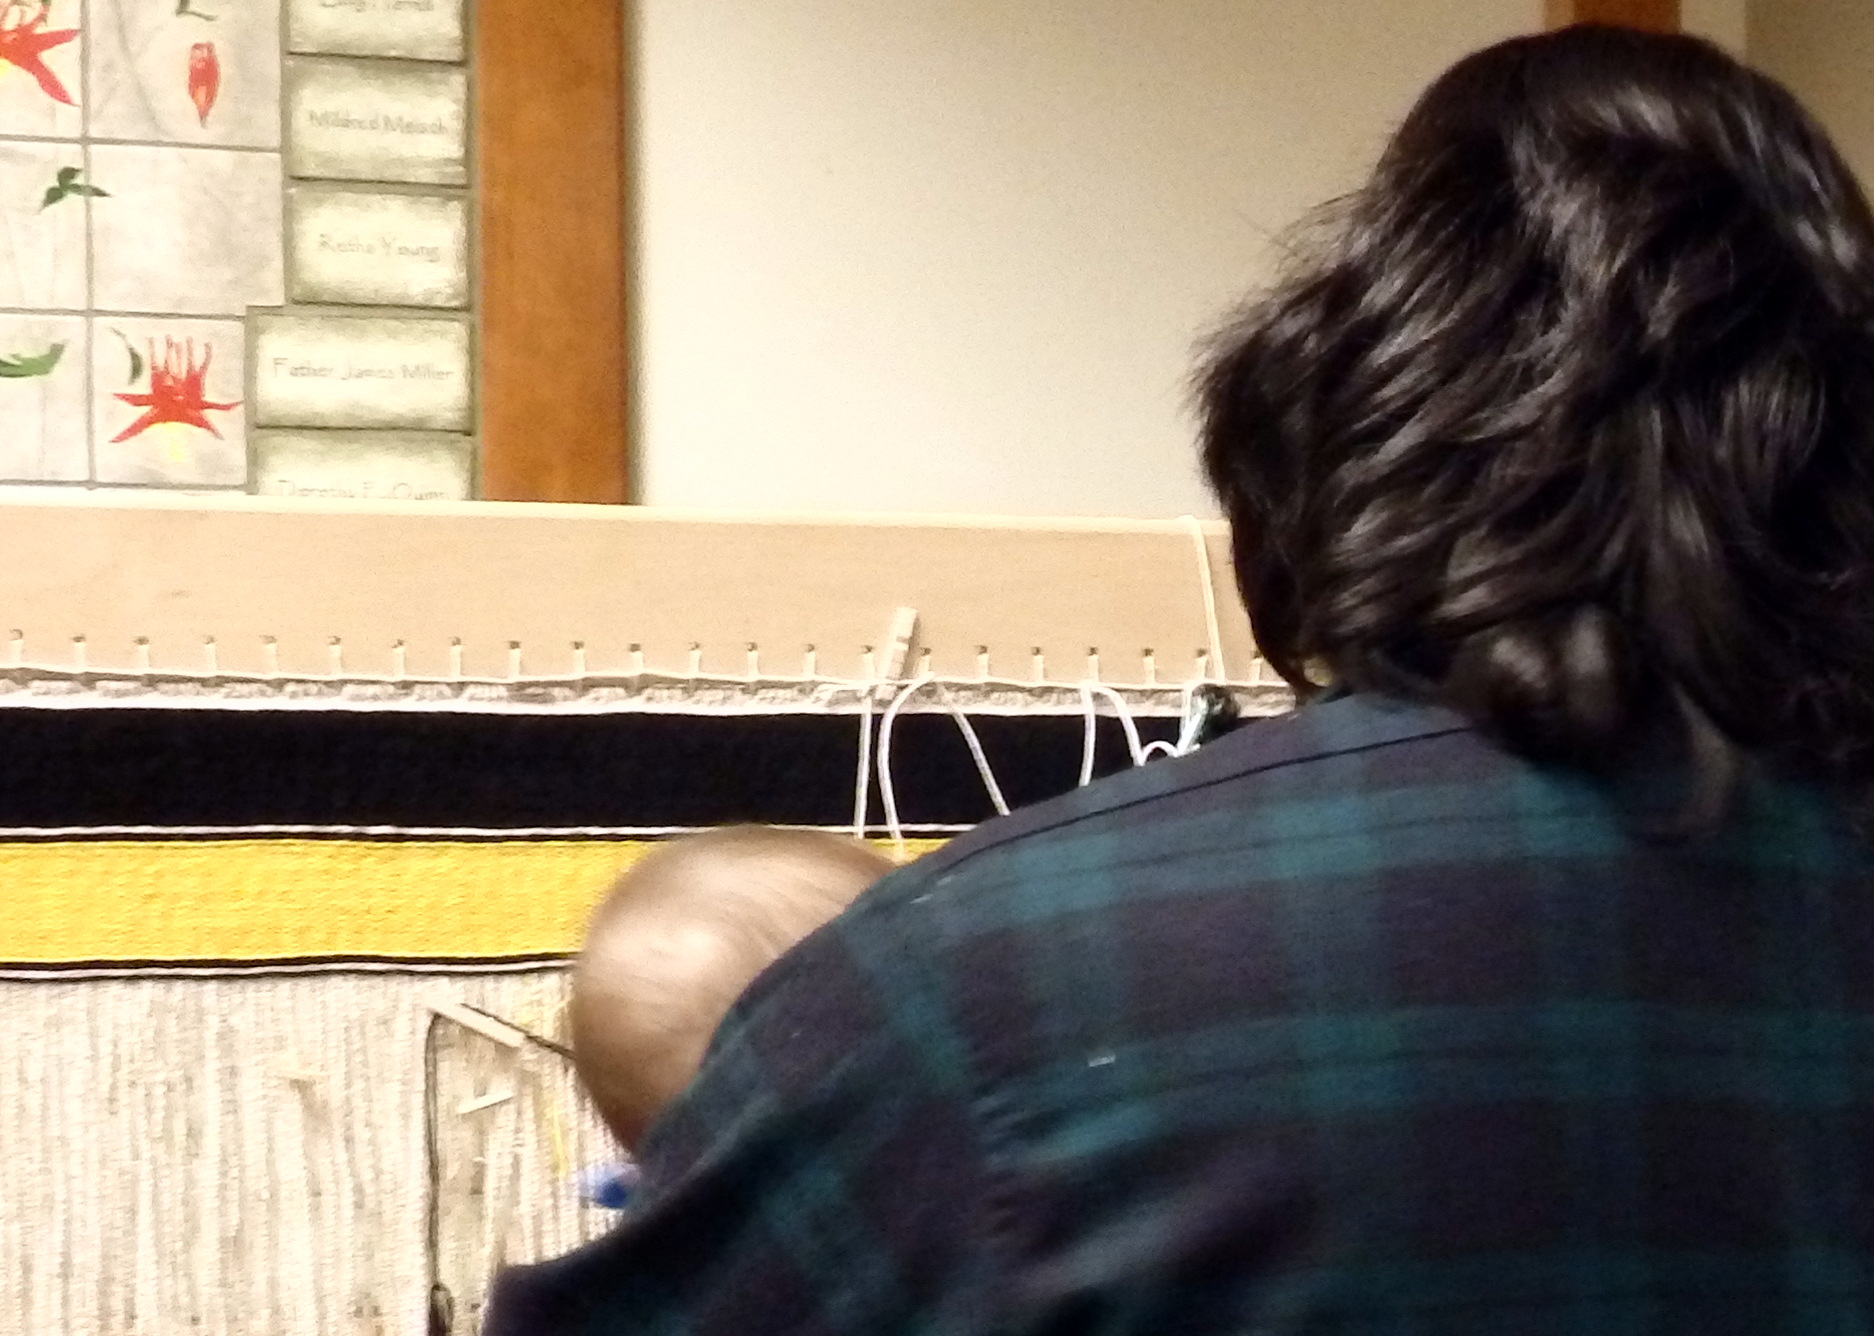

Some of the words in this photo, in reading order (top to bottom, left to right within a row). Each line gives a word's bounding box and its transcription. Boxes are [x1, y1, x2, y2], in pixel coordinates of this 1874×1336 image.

[378, 235, 441, 263] Young
[272, 357, 334, 379] Father
[400, 363, 455, 381] Miller
